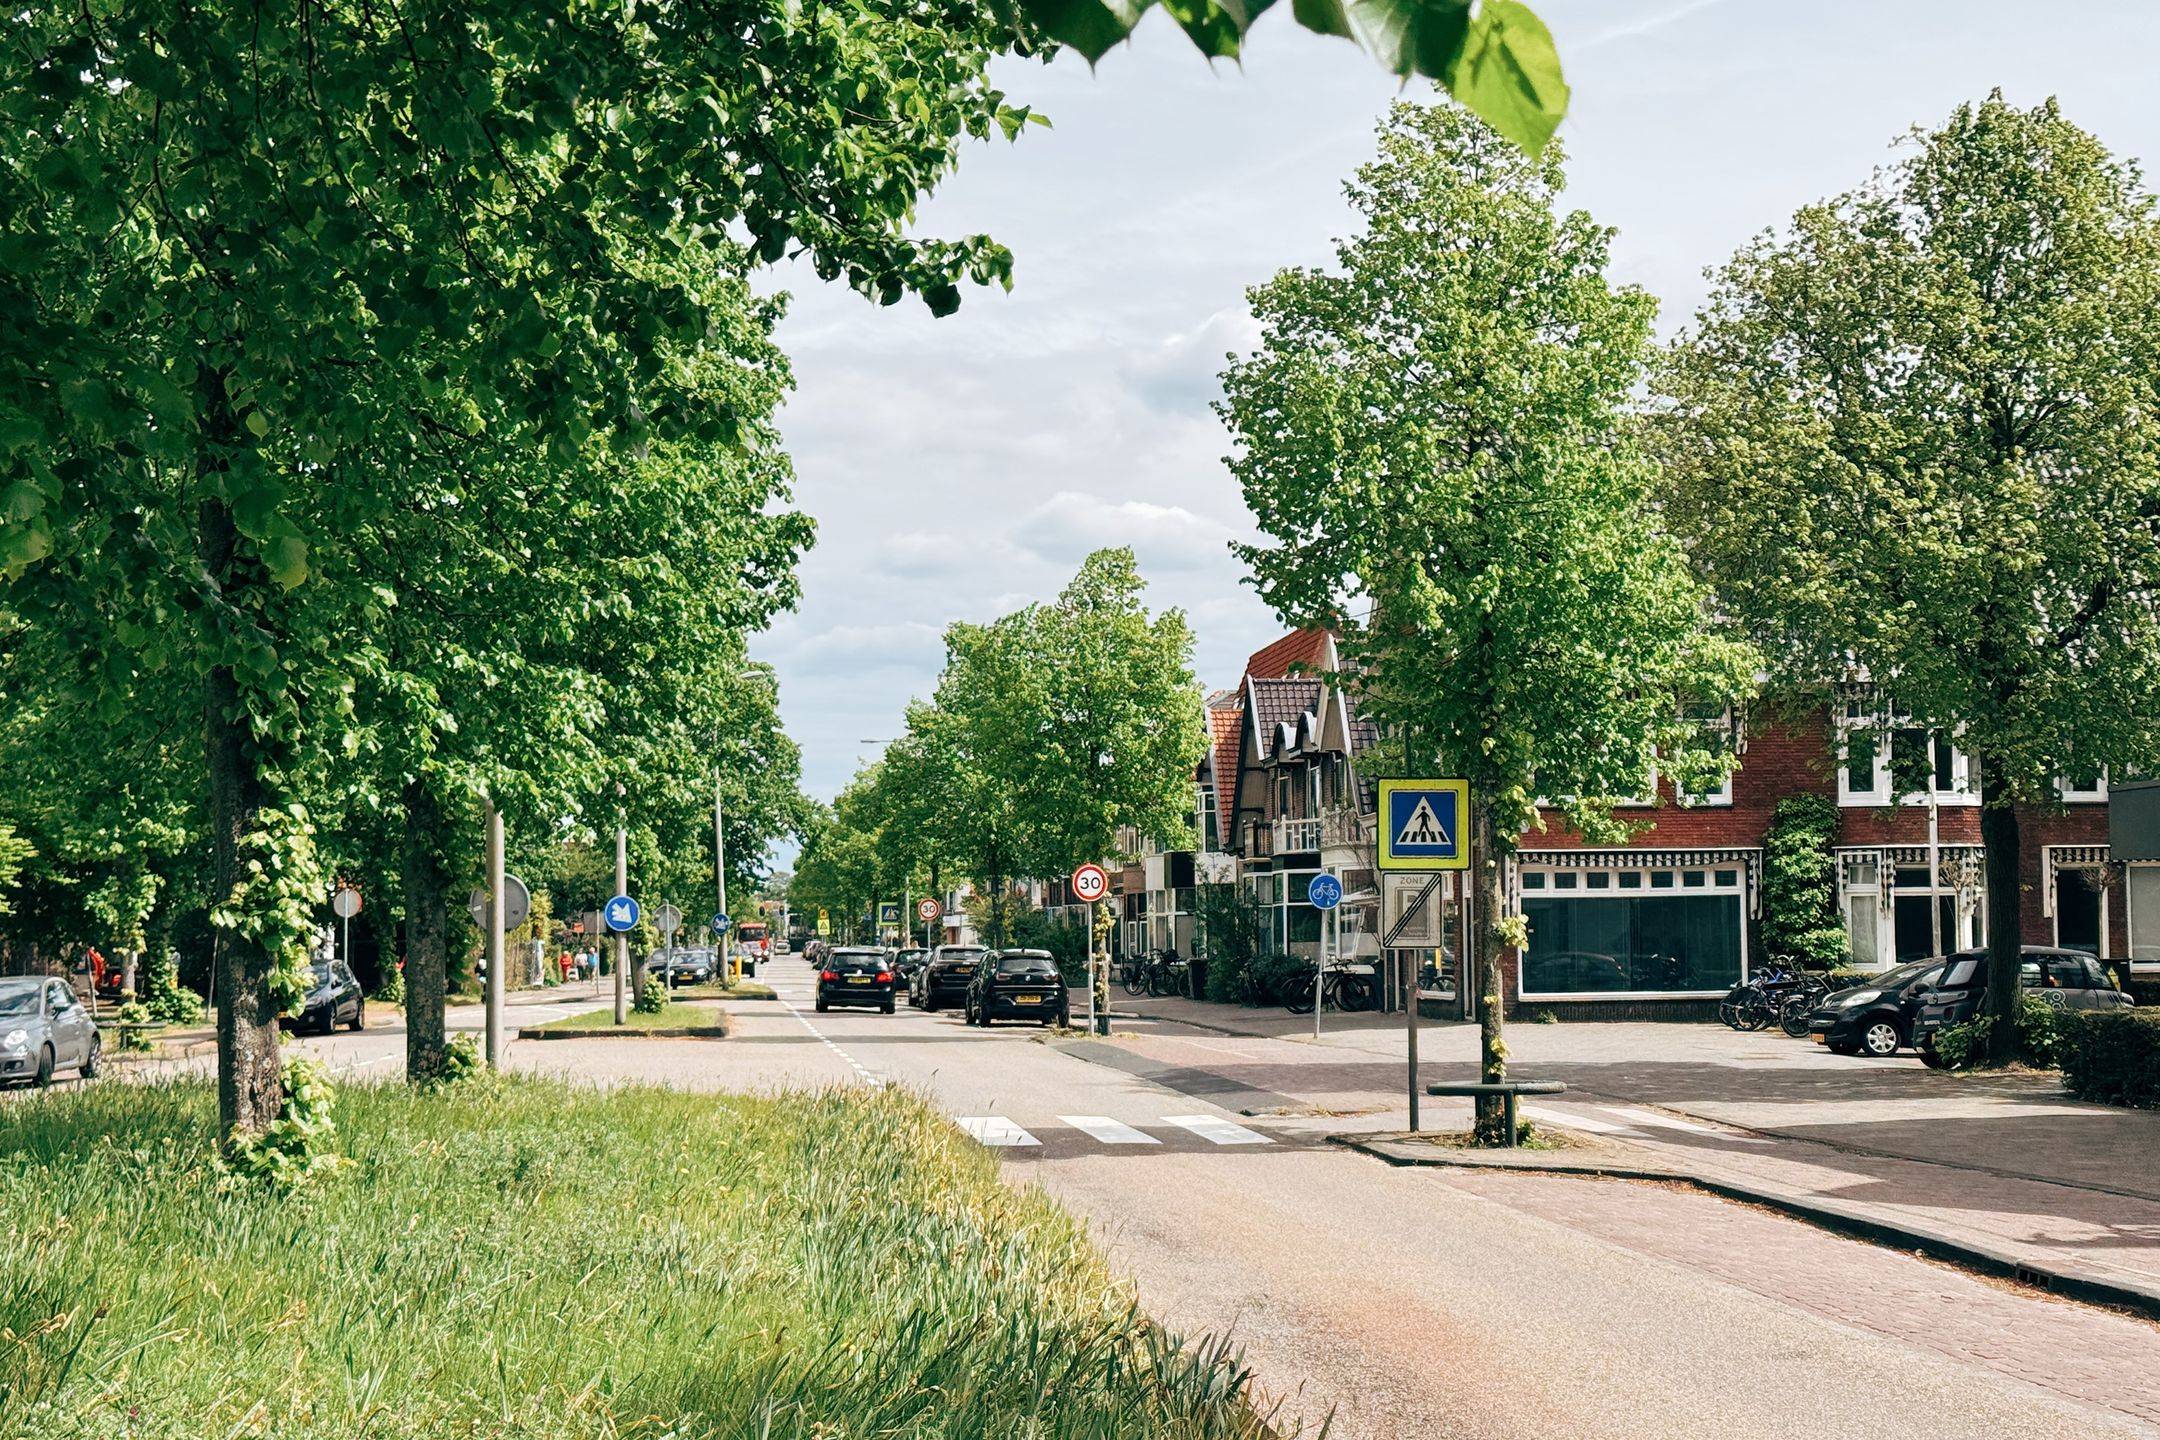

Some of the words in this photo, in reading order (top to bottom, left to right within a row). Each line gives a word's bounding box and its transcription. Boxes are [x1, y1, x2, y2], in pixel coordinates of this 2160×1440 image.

[1080, 877, 1101, 889] 30
[1400, 877, 1425, 885] ZONE
[923, 905, 936, 913] 30
